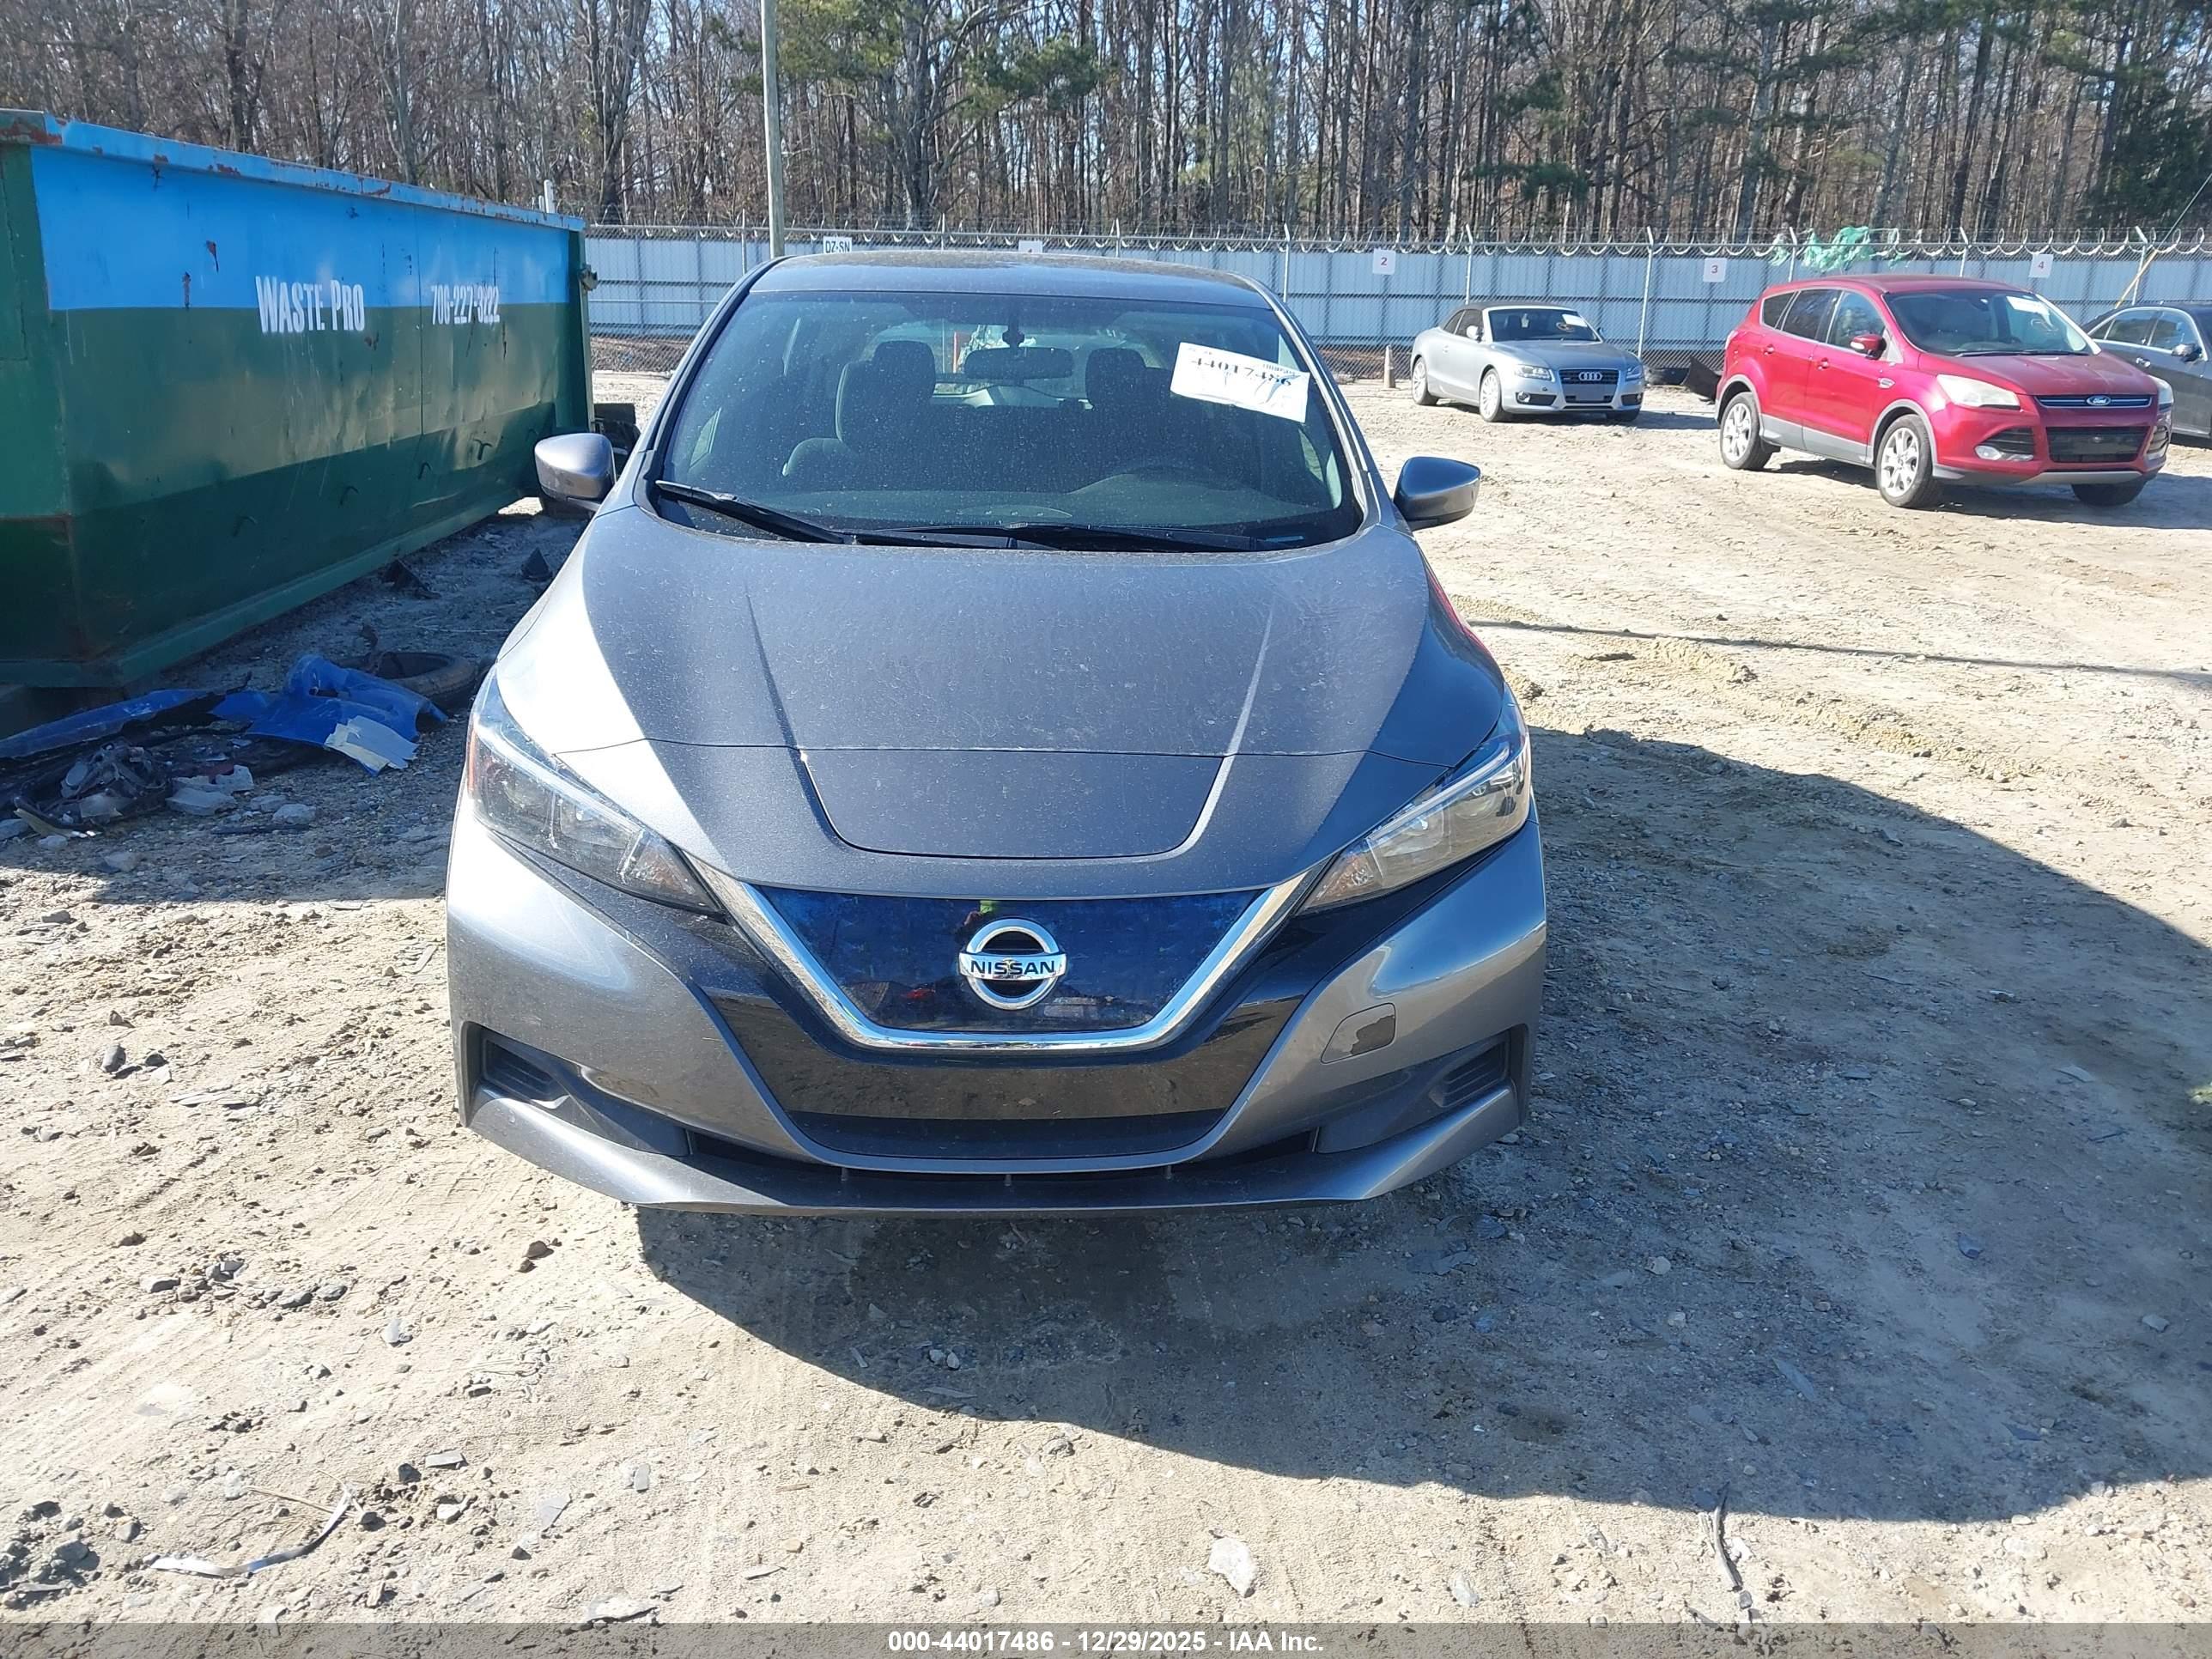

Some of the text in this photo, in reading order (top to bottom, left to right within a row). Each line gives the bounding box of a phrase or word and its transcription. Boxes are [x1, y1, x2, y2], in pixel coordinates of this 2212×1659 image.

[1380, 257, 1388, 266] 2
[2038, 261, 2045, 270] 4
[1711, 264, 1718, 274] 3
[970, 959, 1056, 975] NISSAN
